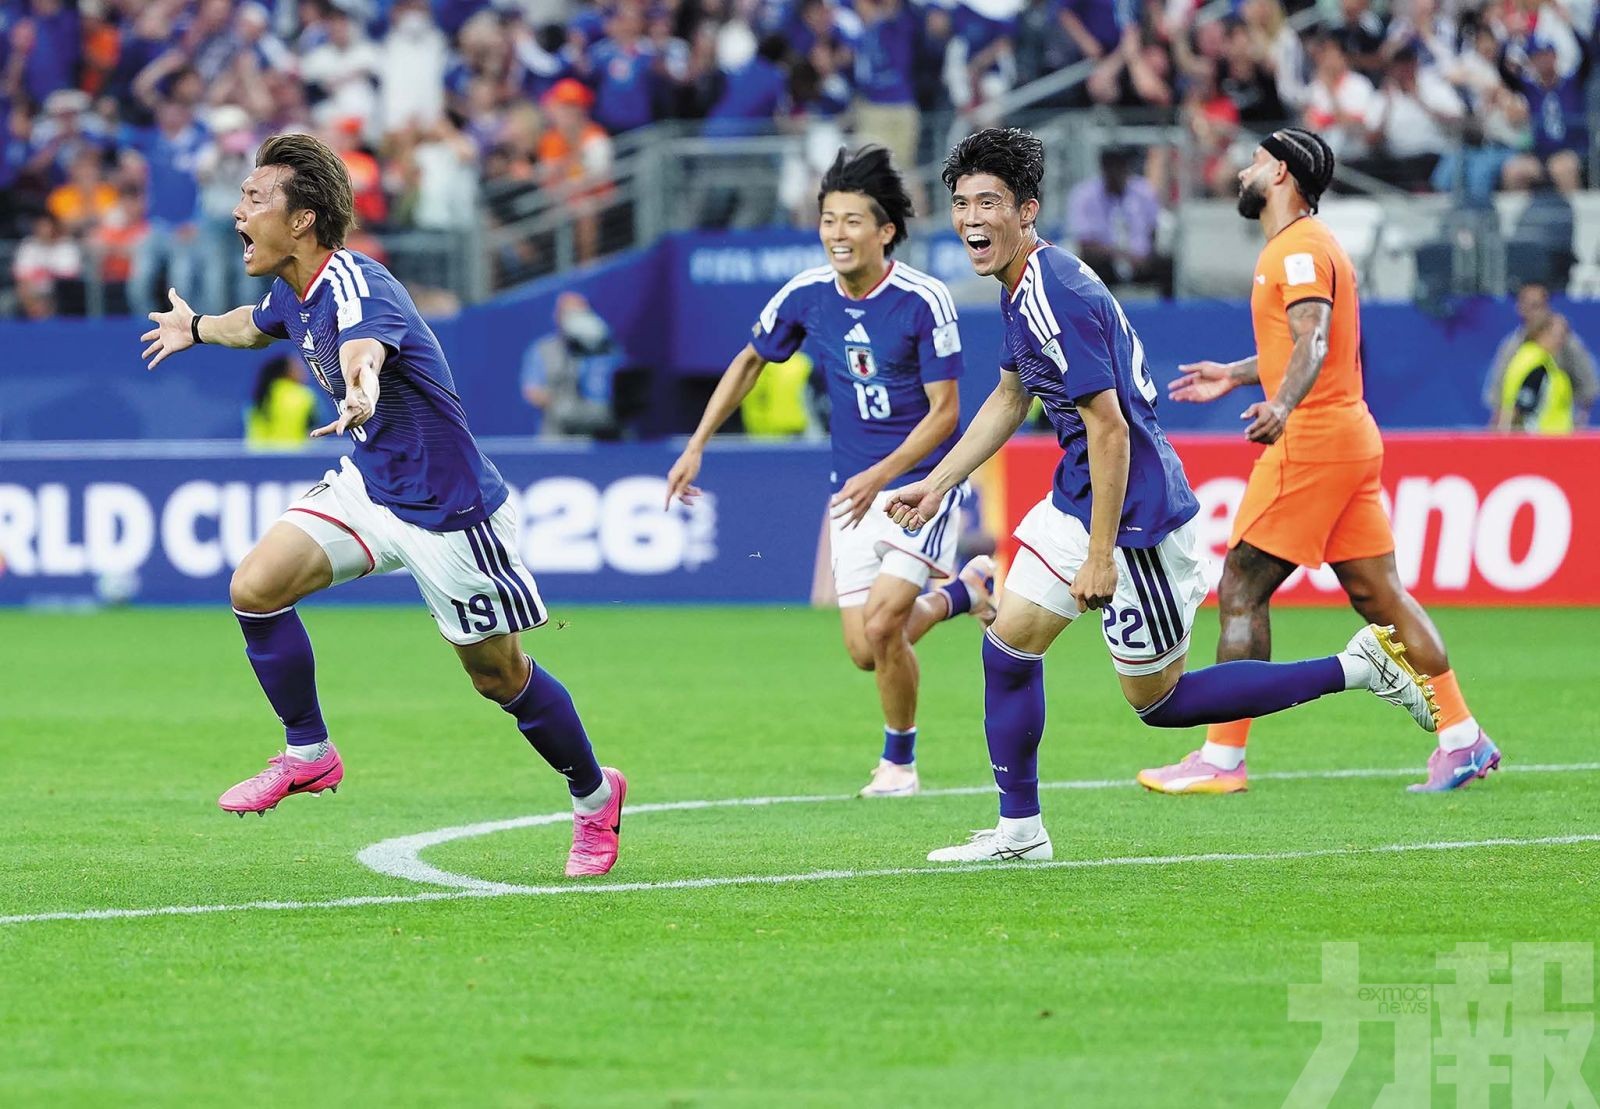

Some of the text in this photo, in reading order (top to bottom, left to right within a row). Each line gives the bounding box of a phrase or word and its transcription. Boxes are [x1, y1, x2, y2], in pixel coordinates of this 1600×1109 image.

[853, 382, 891, 420] 13
[161, 480, 322, 577] CU
[502, 476, 686, 574] 26
[450, 593, 498, 634] 19
[1102, 602, 1147, 649] 22
